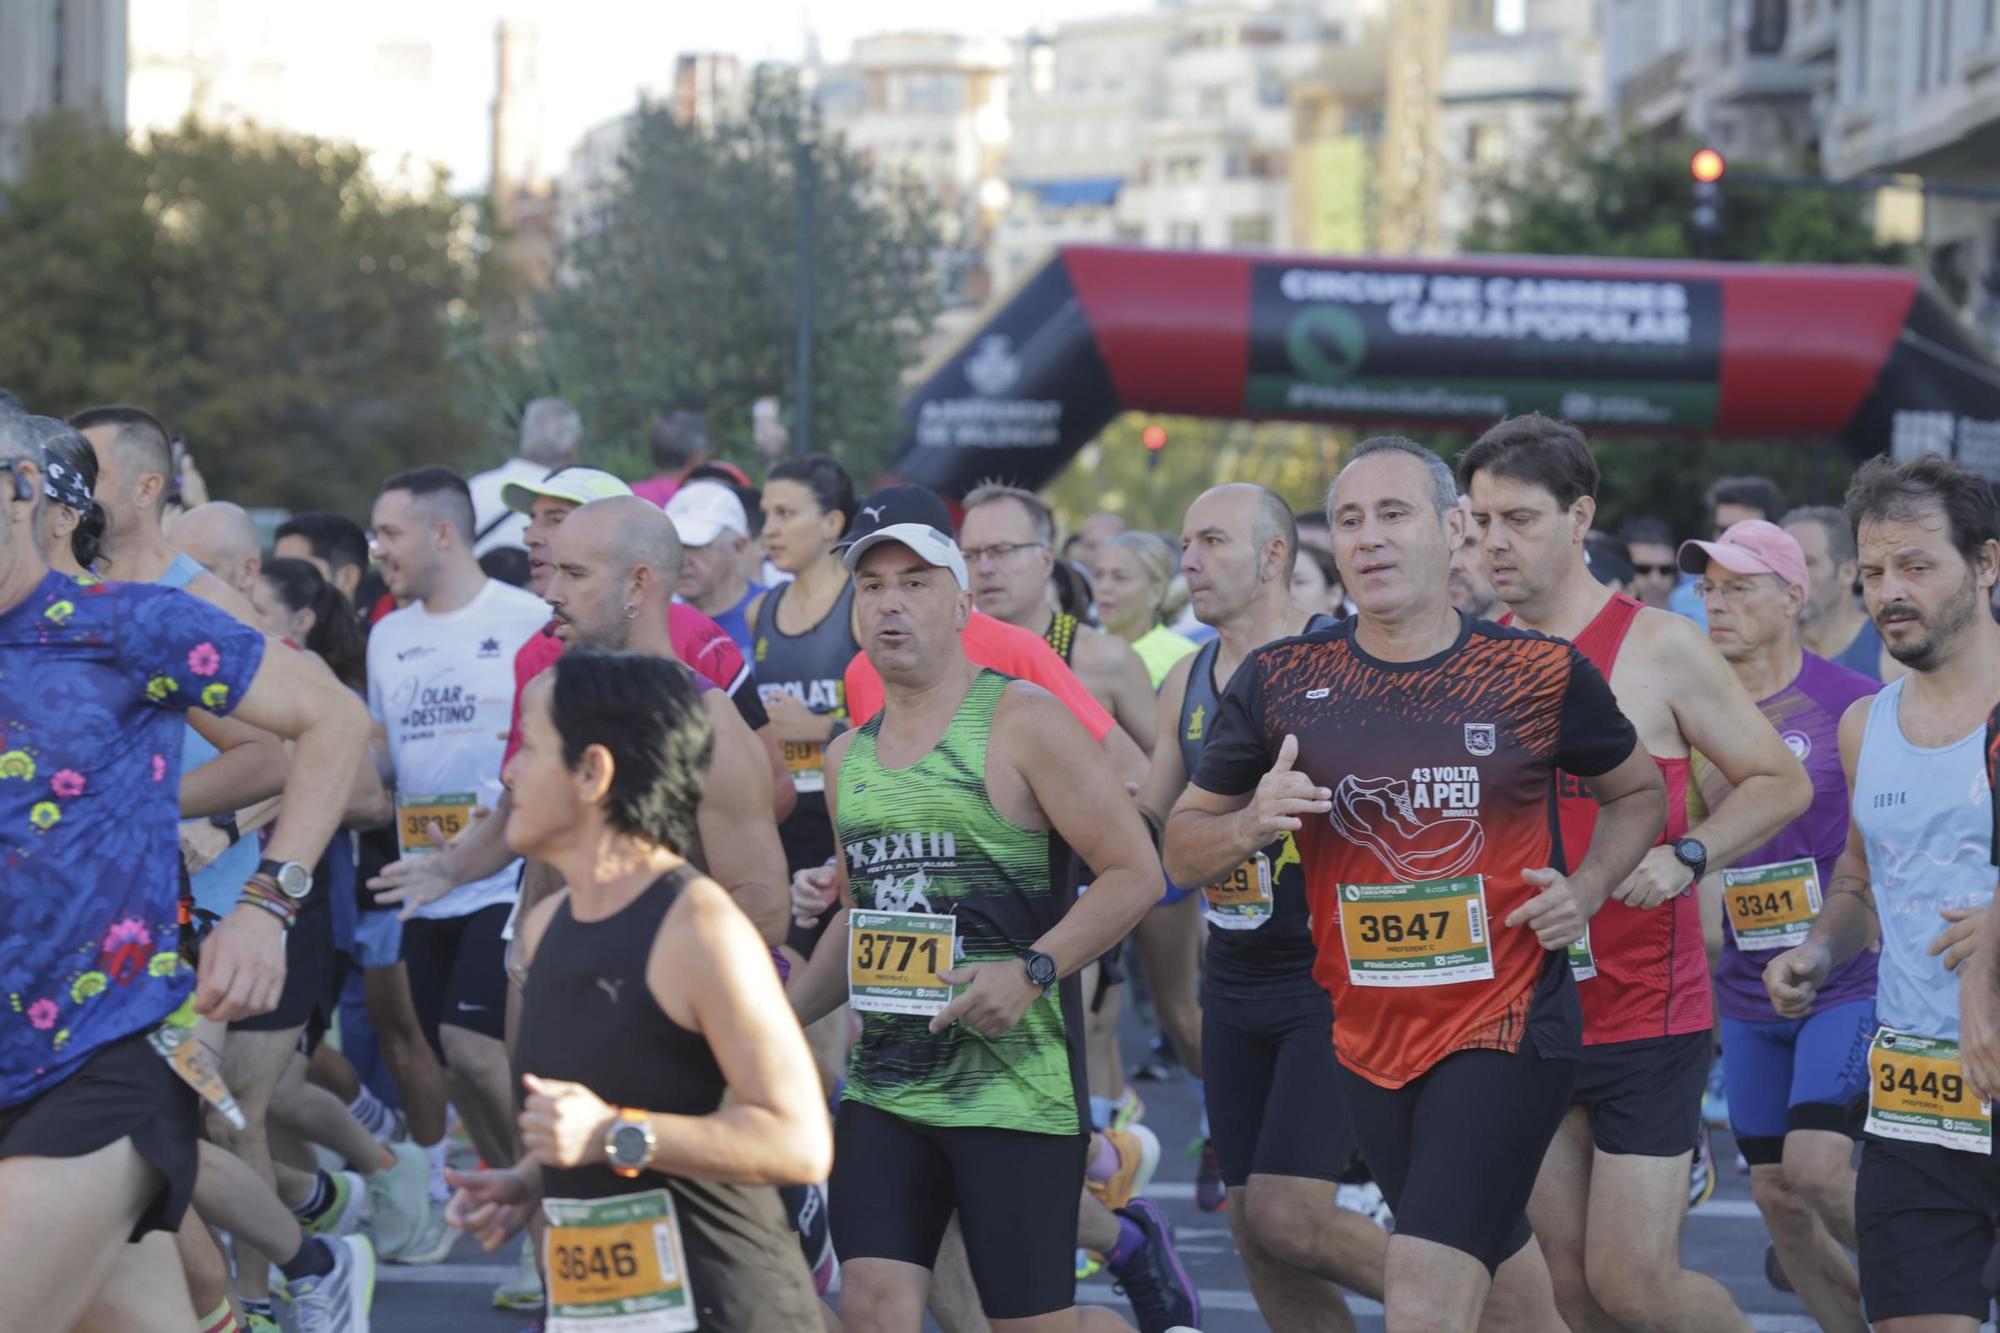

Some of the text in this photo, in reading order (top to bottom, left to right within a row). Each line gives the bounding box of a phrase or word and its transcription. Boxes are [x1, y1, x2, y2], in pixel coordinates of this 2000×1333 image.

[1281, 269, 1688, 310] CIRCUIT DE CARRERES
[1411, 766, 1480, 783] 43 VOLTA
[1413, 782, 1480, 809] A PEU
[1736, 890, 1793, 917] 3341
[1359, 911, 1450, 943] 3647
[857, 933, 938, 974] 3771
[1880, 1063, 1963, 1104] 3449
[556, 1241, 638, 1281] 3646
